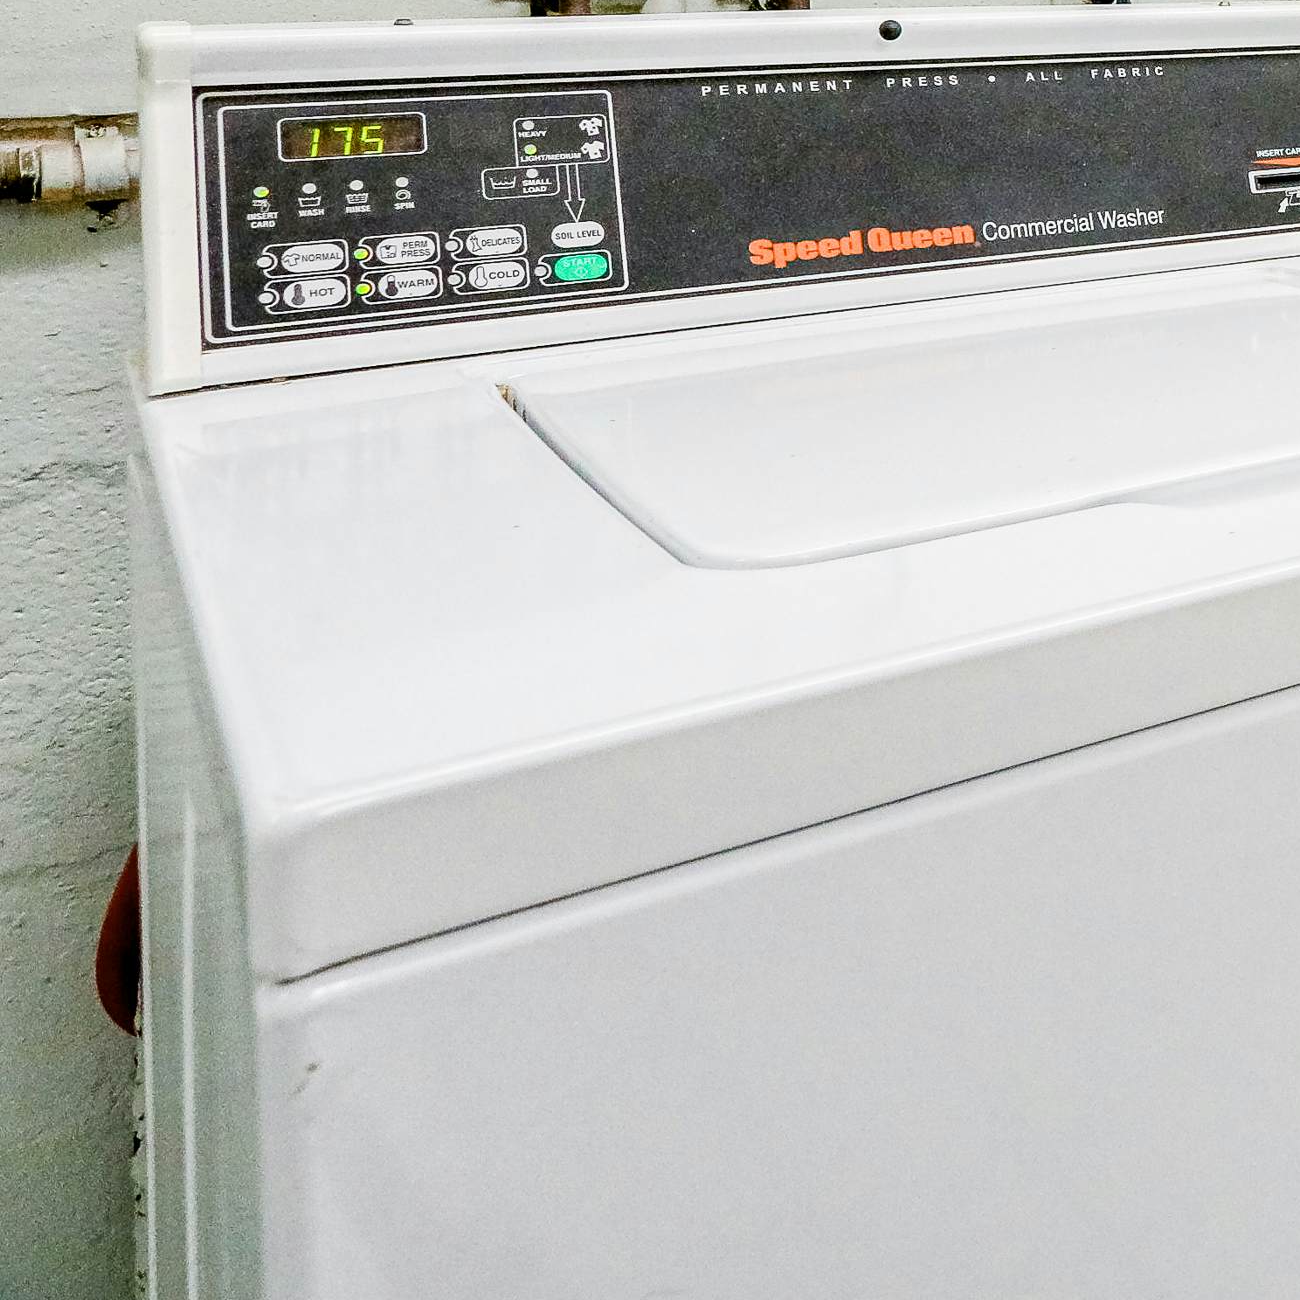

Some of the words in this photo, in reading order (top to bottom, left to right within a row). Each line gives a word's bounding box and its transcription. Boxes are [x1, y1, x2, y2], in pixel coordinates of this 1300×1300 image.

[700, 78, 854, 97] PERMANENT
[886, 74, 960, 88] PRESS
[1025, 70, 1064, 81] ALL
[1090, 65, 1165, 80] FABRIC
[518, 130, 547, 138] HEAVY
[309, 124, 384, 158] 175
[520, 152, 582, 163] LIGHT/MEDIUM
[1256, 148, 1284, 158] INSERT
[522, 178, 552, 186] SMALL
[522, 185, 547, 194] LOAD
[345, 204, 371, 214] RINSE
[394, 201, 415, 211] SPIN
[247, 211, 279, 221] INSERT
[298, 208, 325, 217] WASH
[250, 220, 276, 229] CARD
[555, 231, 574, 239] SOIL
[577, 229, 602, 239] LEVEL
[748, 230, 863, 269] Speed
[867, 222, 976, 253] Queen
[982, 212, 1094, 242] Commercial
[1097, 208, 1165, 230] Washer
[402, 240, 428, 249] PERM
[481, 236, 521, 247] DELICATES
[301, 253, 342, 262] NORMAL
[401, 248, 431, 258] PRESS
[562, 256, 598, 268] START
[488, 269, 520, 279] COLD
[397, 278, 435, 288] WARM
[309, 287, 336, 297] HOT
